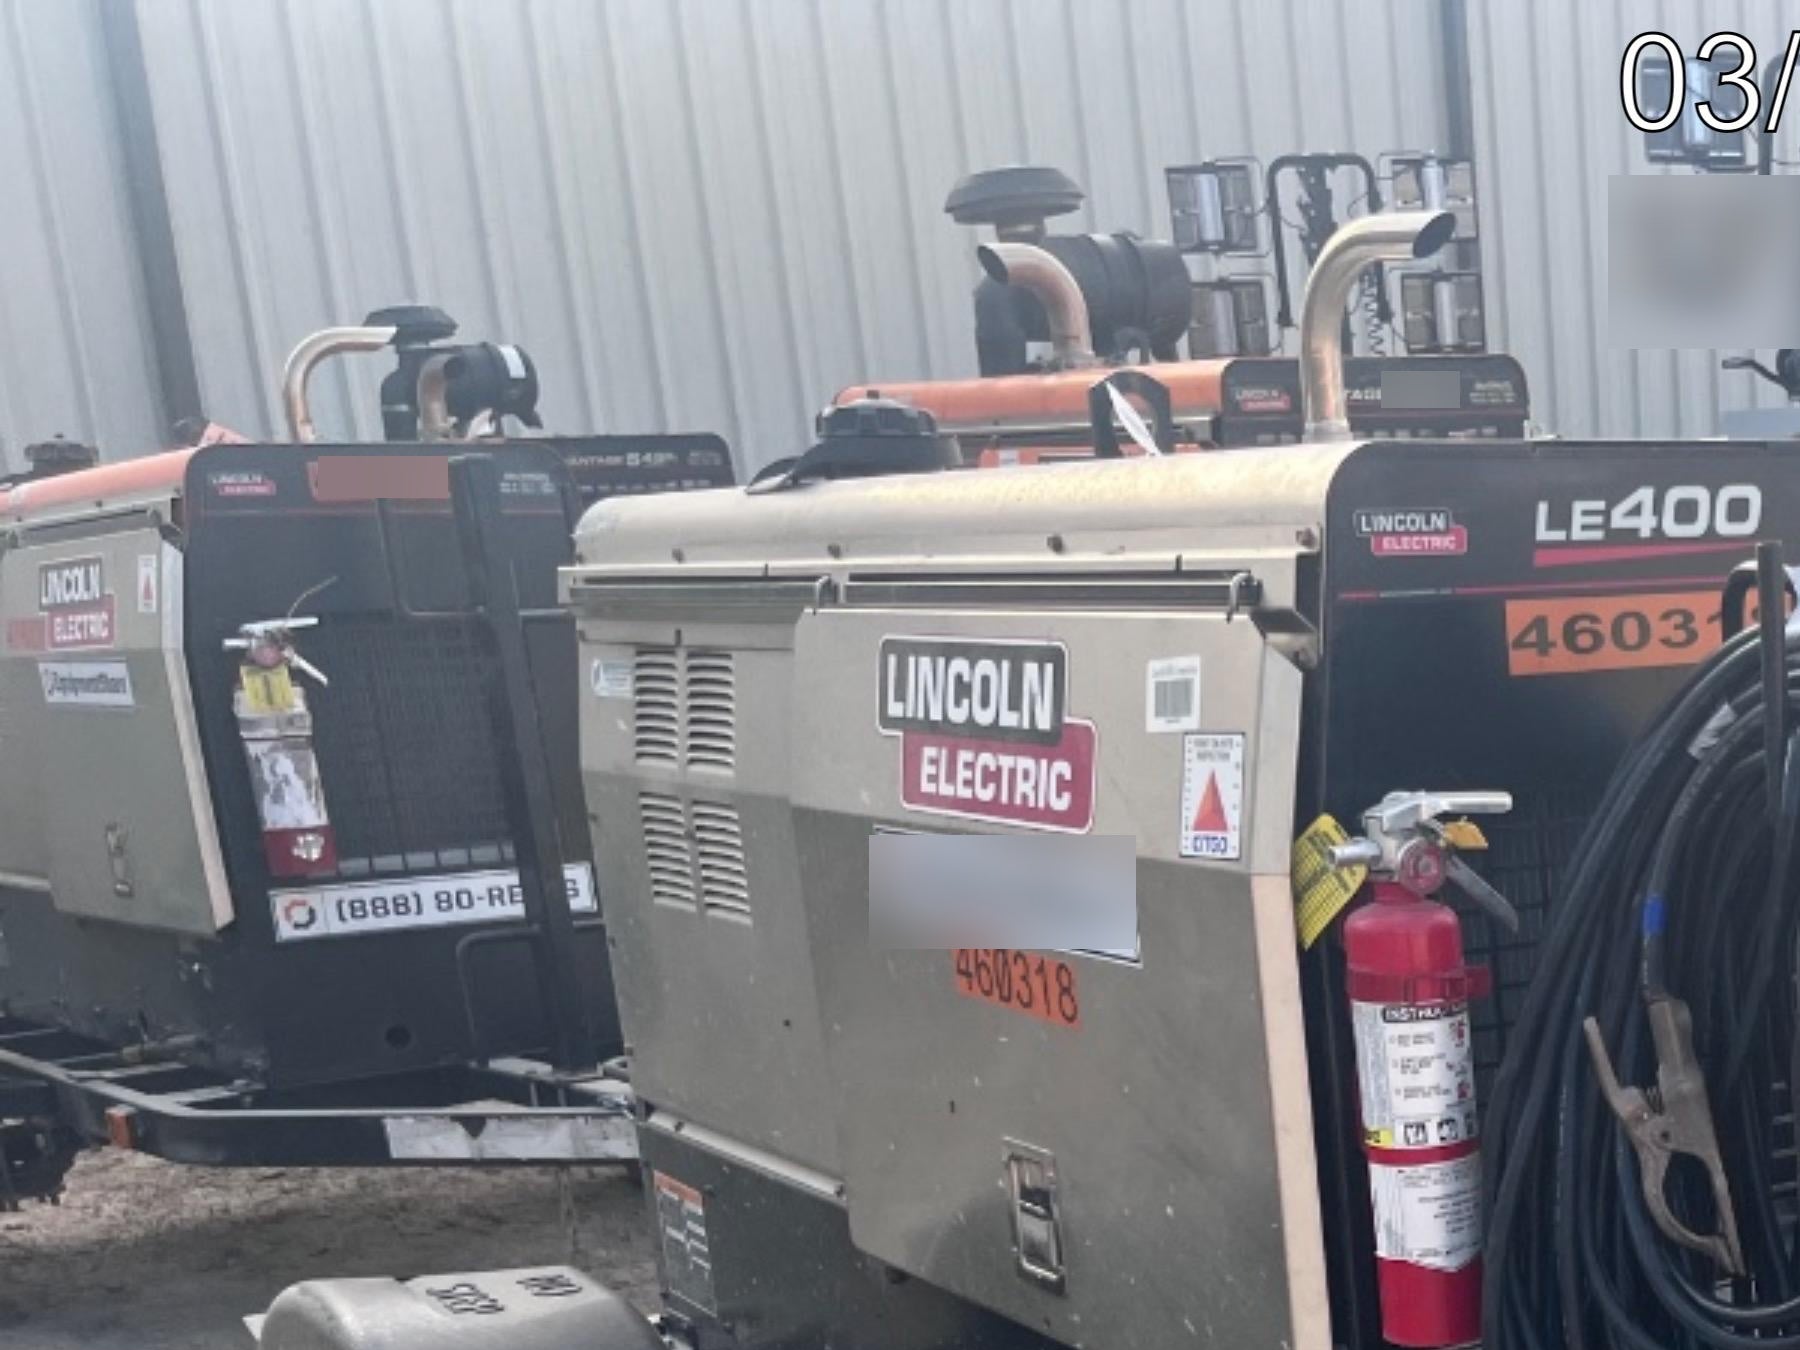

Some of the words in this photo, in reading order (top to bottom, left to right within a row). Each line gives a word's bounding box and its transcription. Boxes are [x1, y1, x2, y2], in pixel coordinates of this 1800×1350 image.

[1361, 512, 1447, 532] LINCOLN
[1535, 484, 1762, 541] LE400
[1382, 536, 1456, 550] ELECTRIC
[40, 563, 100, 605] LINCOLN
[1511, 606, 1760, 657] 4603
[887, 653, 1054, 731] LINCOLN
[919, 746, 1073, 811] ELECTRIC
[337, 892, 424, 923] (888)
[434, 878, 580, 912] 80-RES
[956, 949, 1078, 1023] 460318
